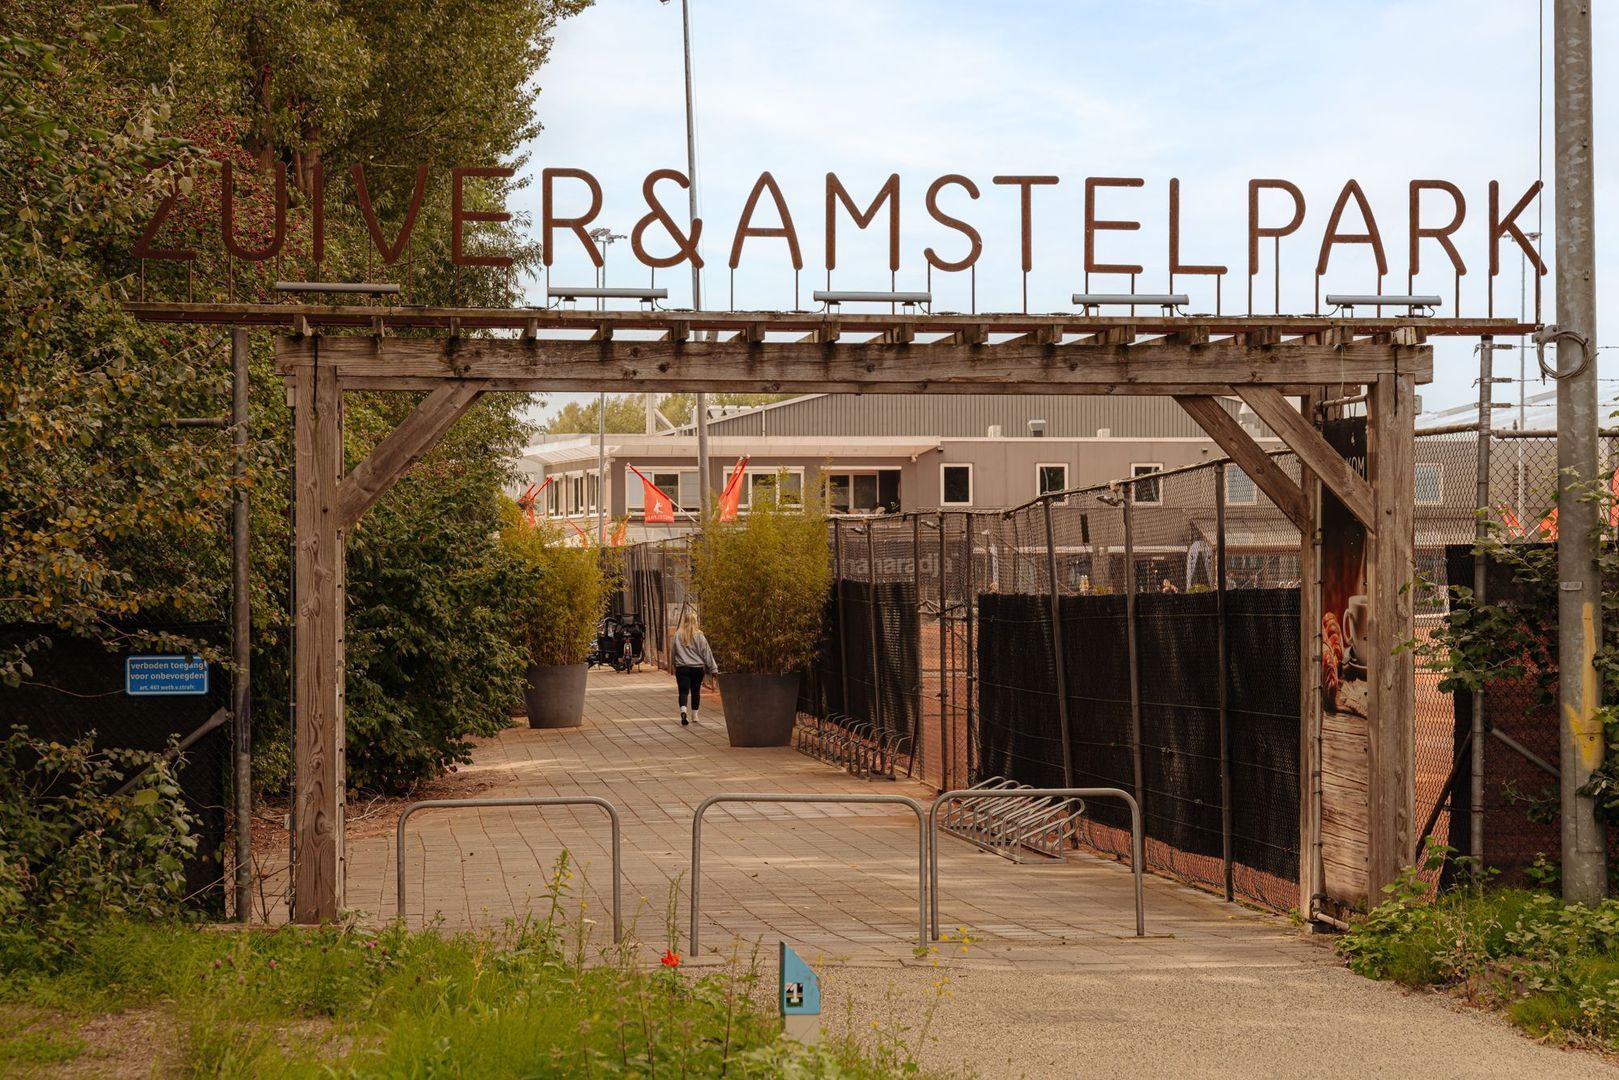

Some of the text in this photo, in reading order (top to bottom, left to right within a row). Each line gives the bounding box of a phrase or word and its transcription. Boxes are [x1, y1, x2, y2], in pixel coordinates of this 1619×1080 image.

[130, 662, 204, 670] verboden toegang
[151, 673, 205, 681] onbevoegden
